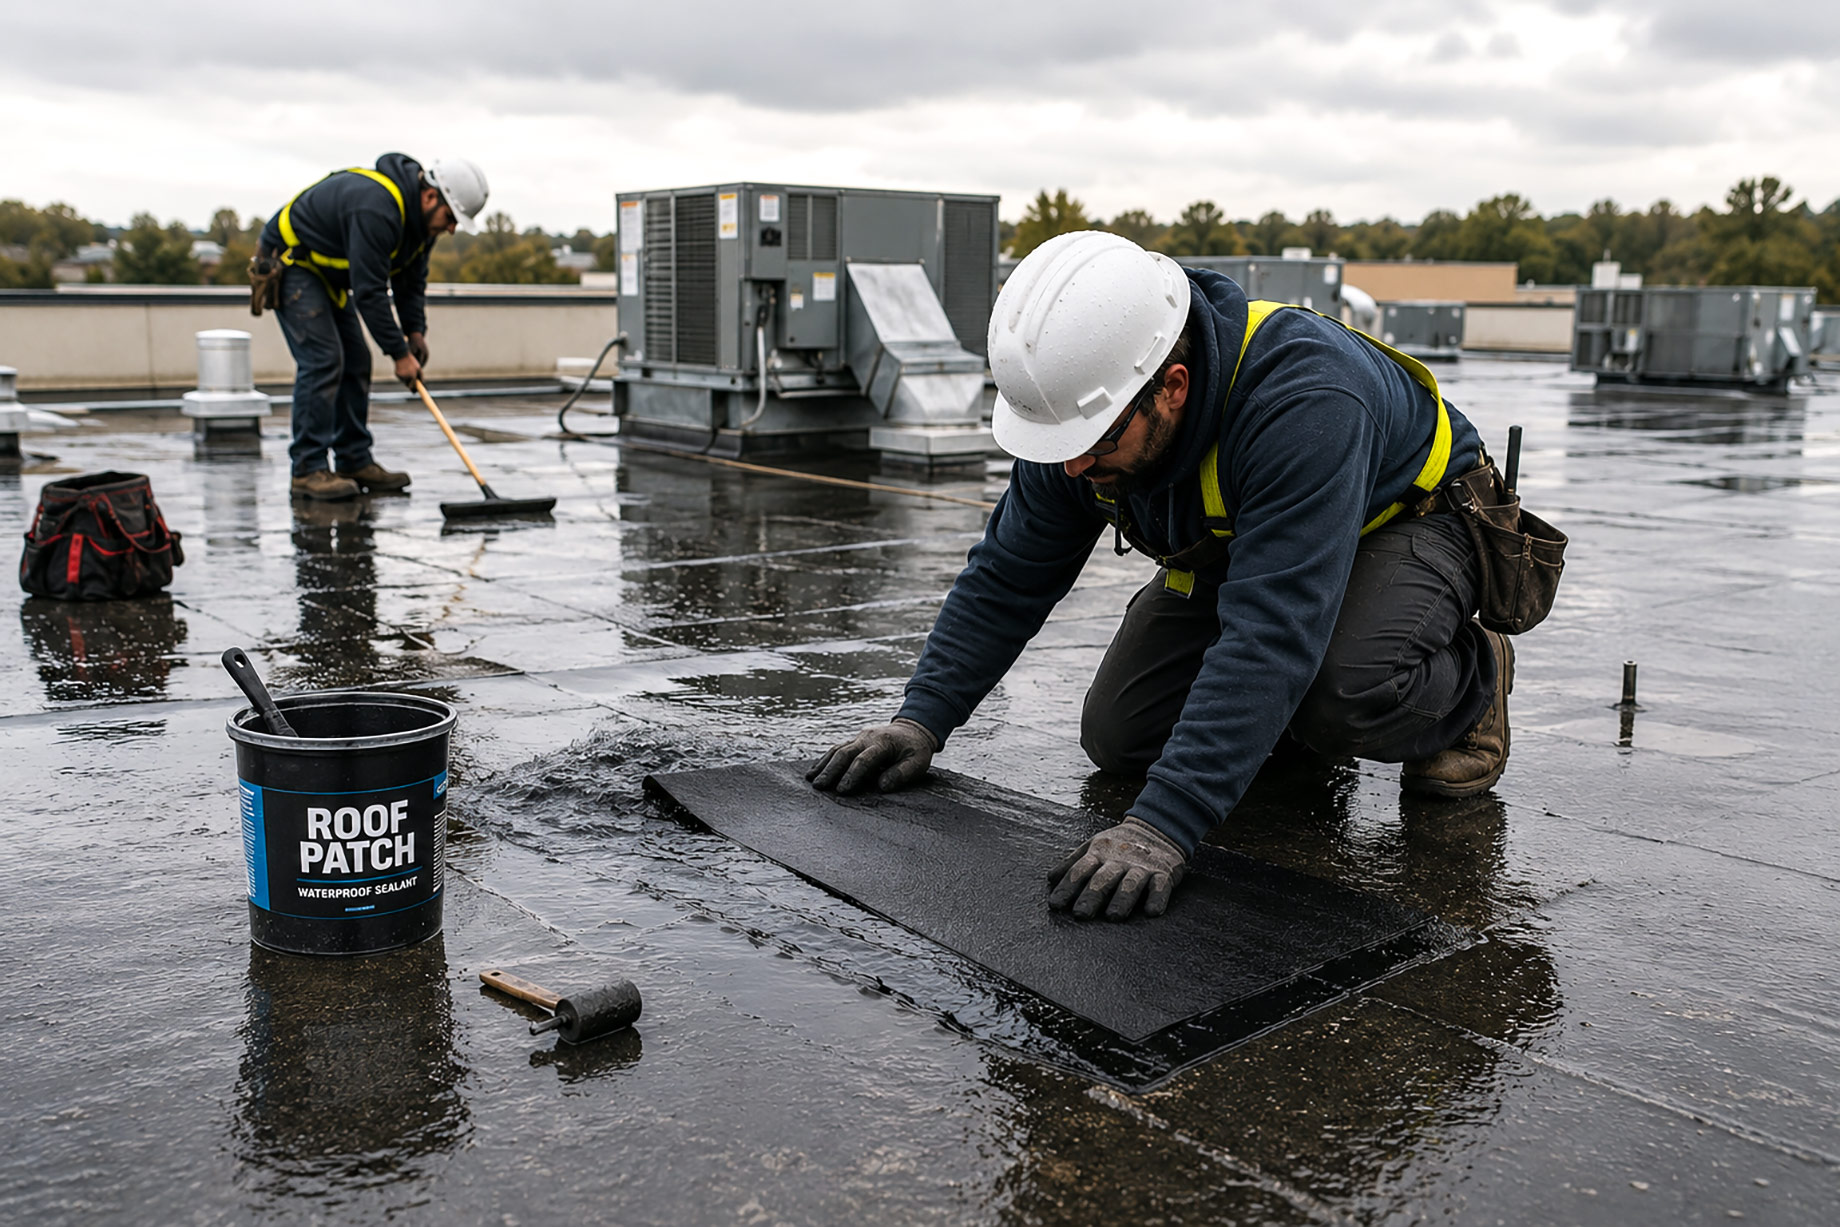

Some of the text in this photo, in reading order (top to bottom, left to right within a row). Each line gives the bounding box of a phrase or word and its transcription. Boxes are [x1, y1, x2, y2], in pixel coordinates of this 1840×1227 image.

[307, 799, 409, 840] ROOF
[300, 831, 415, 874] PATCH
[298, 876, 418, 899] WATERPROOF SEALANT
